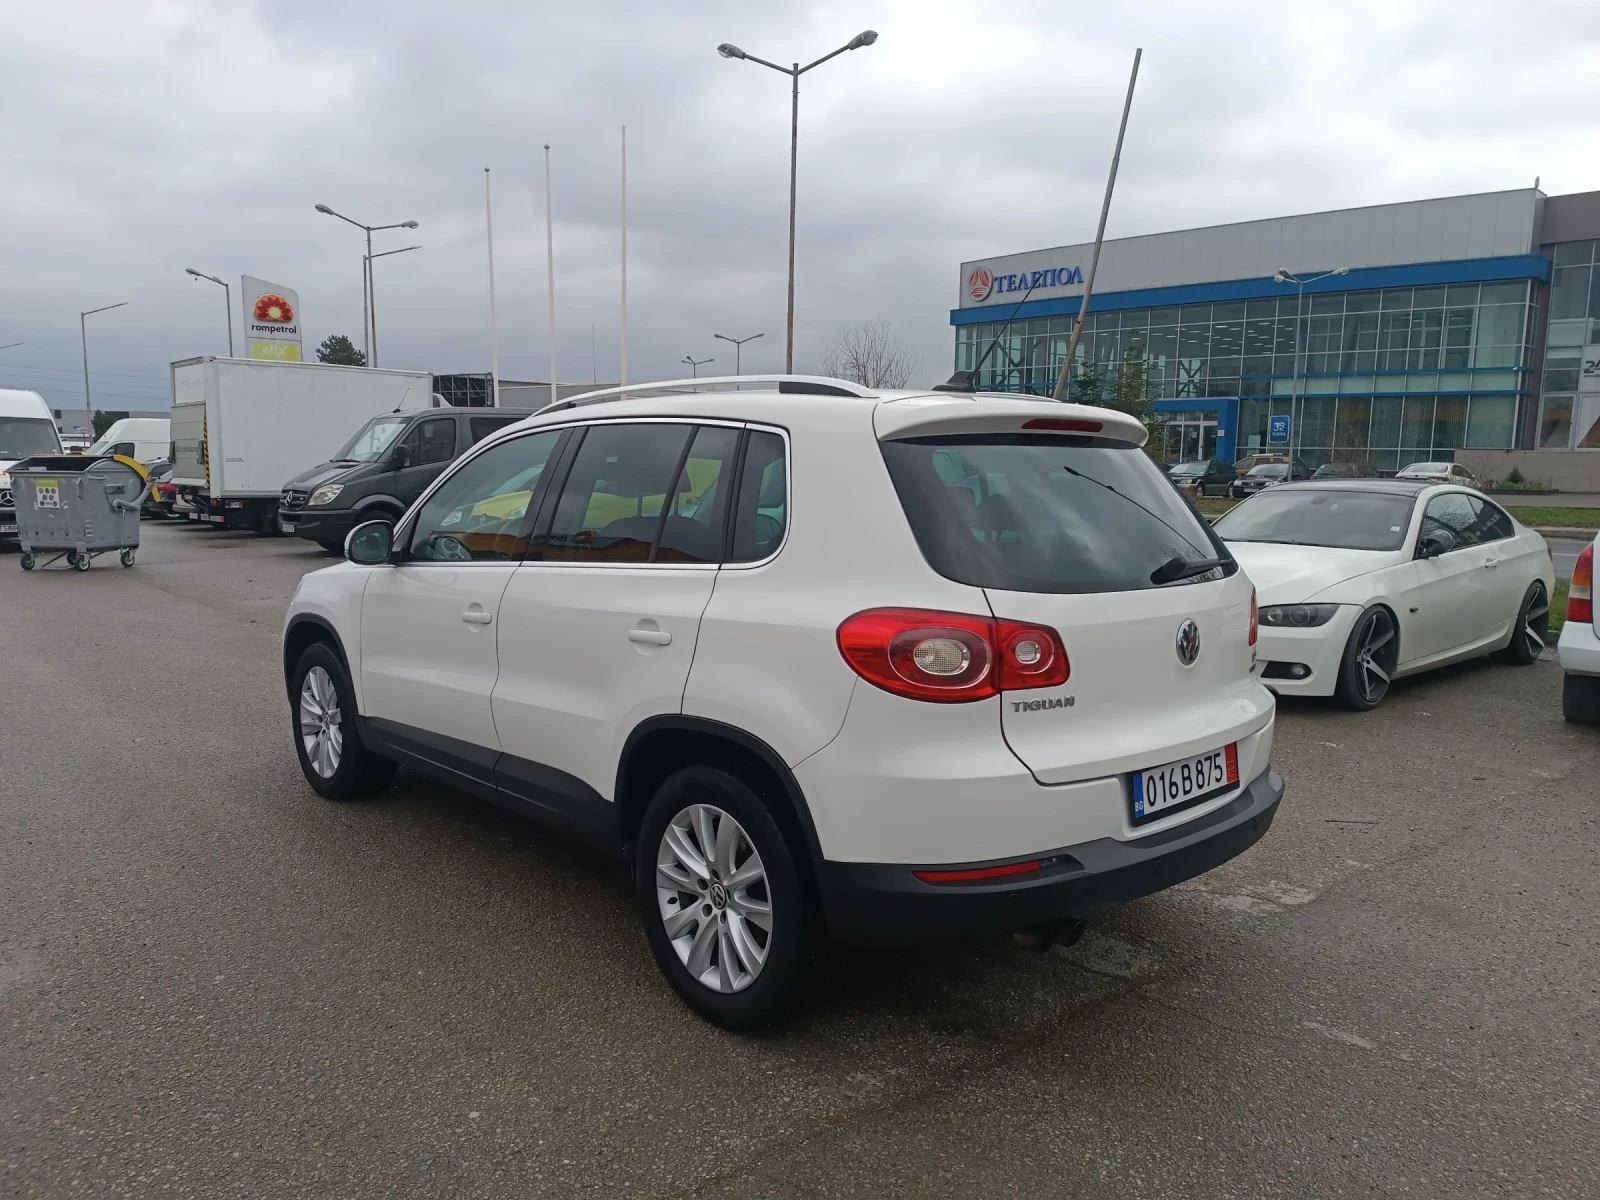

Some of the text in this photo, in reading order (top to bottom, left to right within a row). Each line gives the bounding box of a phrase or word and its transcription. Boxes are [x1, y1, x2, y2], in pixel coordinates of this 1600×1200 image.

[993, 265, 1084, 294] ТЕЛЕПОЛ
[251, 324, 297, 334] rompetrol
[1011, 695, 1075, 713] TIGUAN
[1134, 800, 1144, 812] BG
